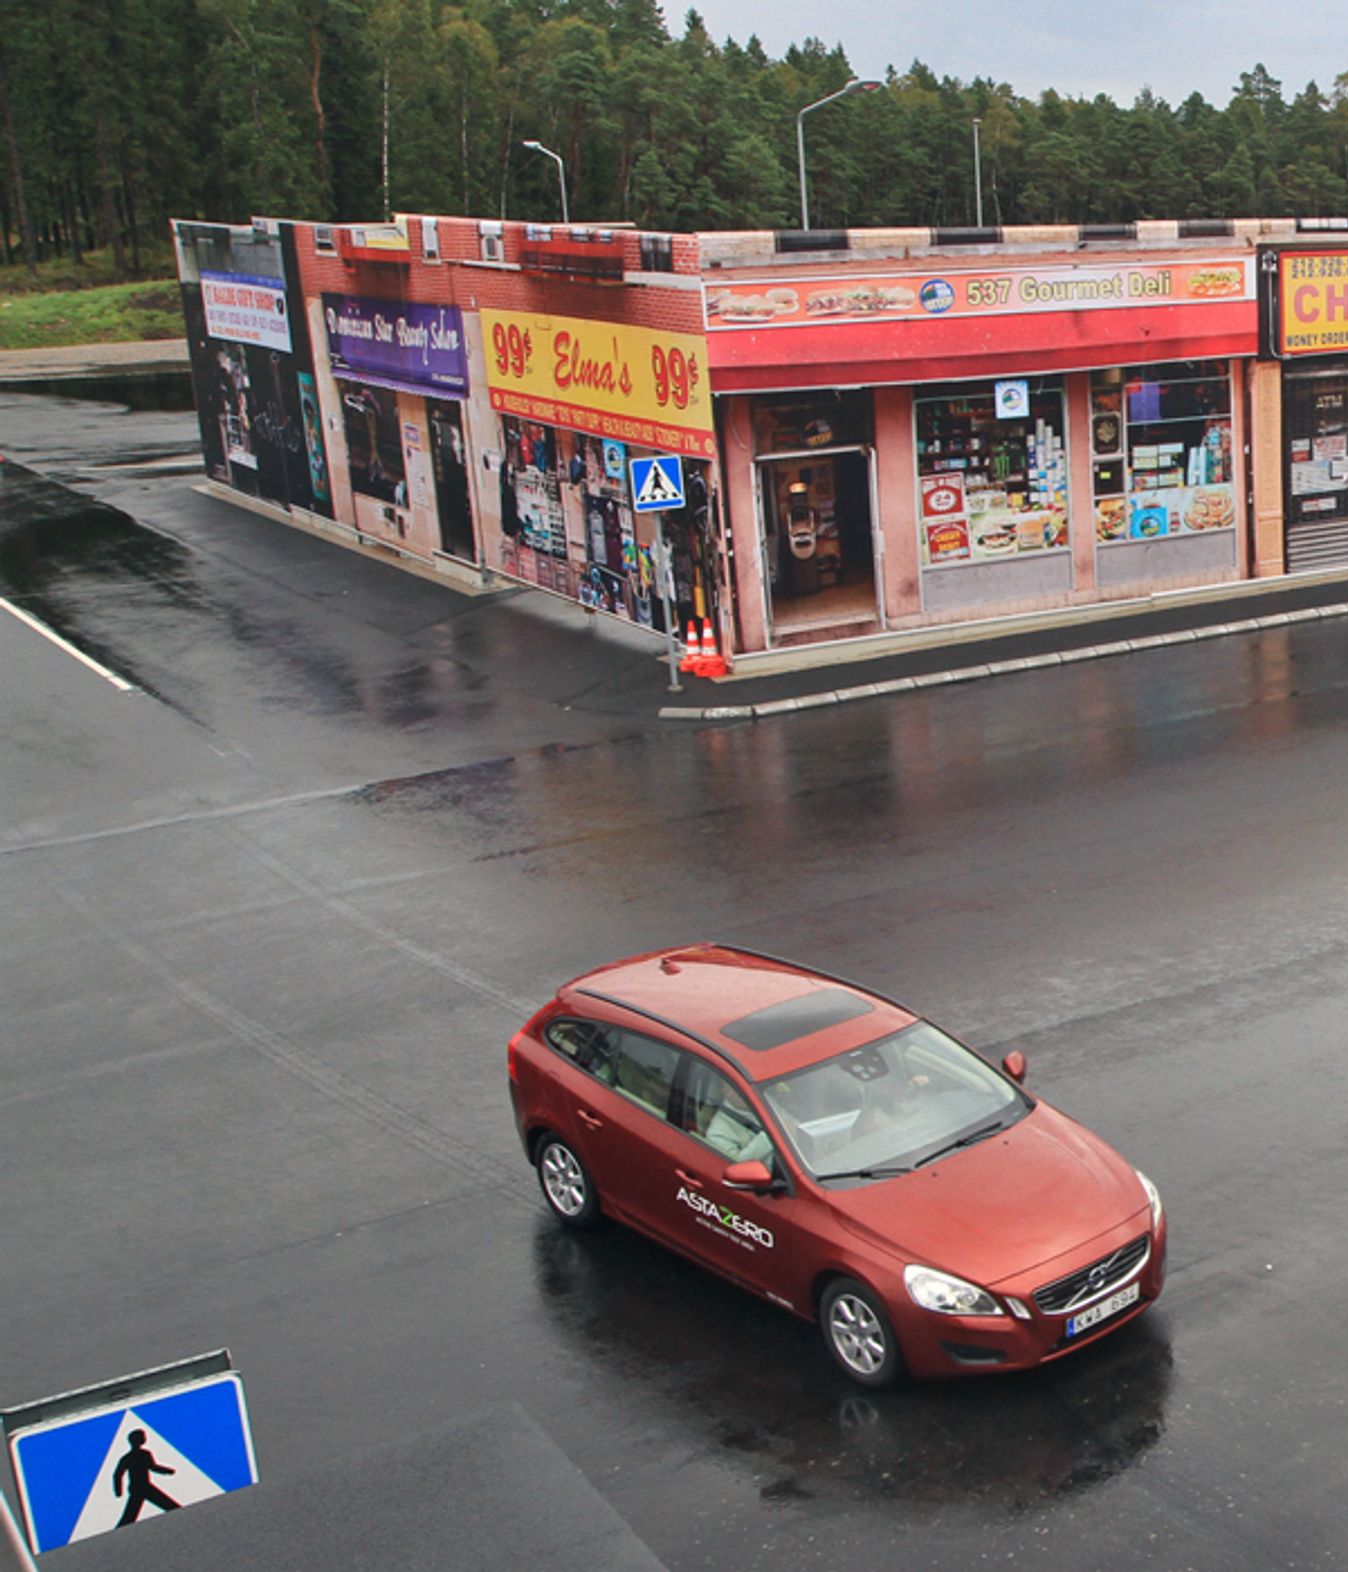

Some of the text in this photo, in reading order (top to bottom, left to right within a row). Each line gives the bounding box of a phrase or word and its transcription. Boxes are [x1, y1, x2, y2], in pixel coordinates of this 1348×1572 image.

[966, 279, 1011, 306] 537
[1019, 273, 1123, 302] Gourmet
[1128, 270, 1172, 297] Deli
[553, 330, 633, 397] Elma's
[676, 1186, 774, 1249] ASTAZERO
